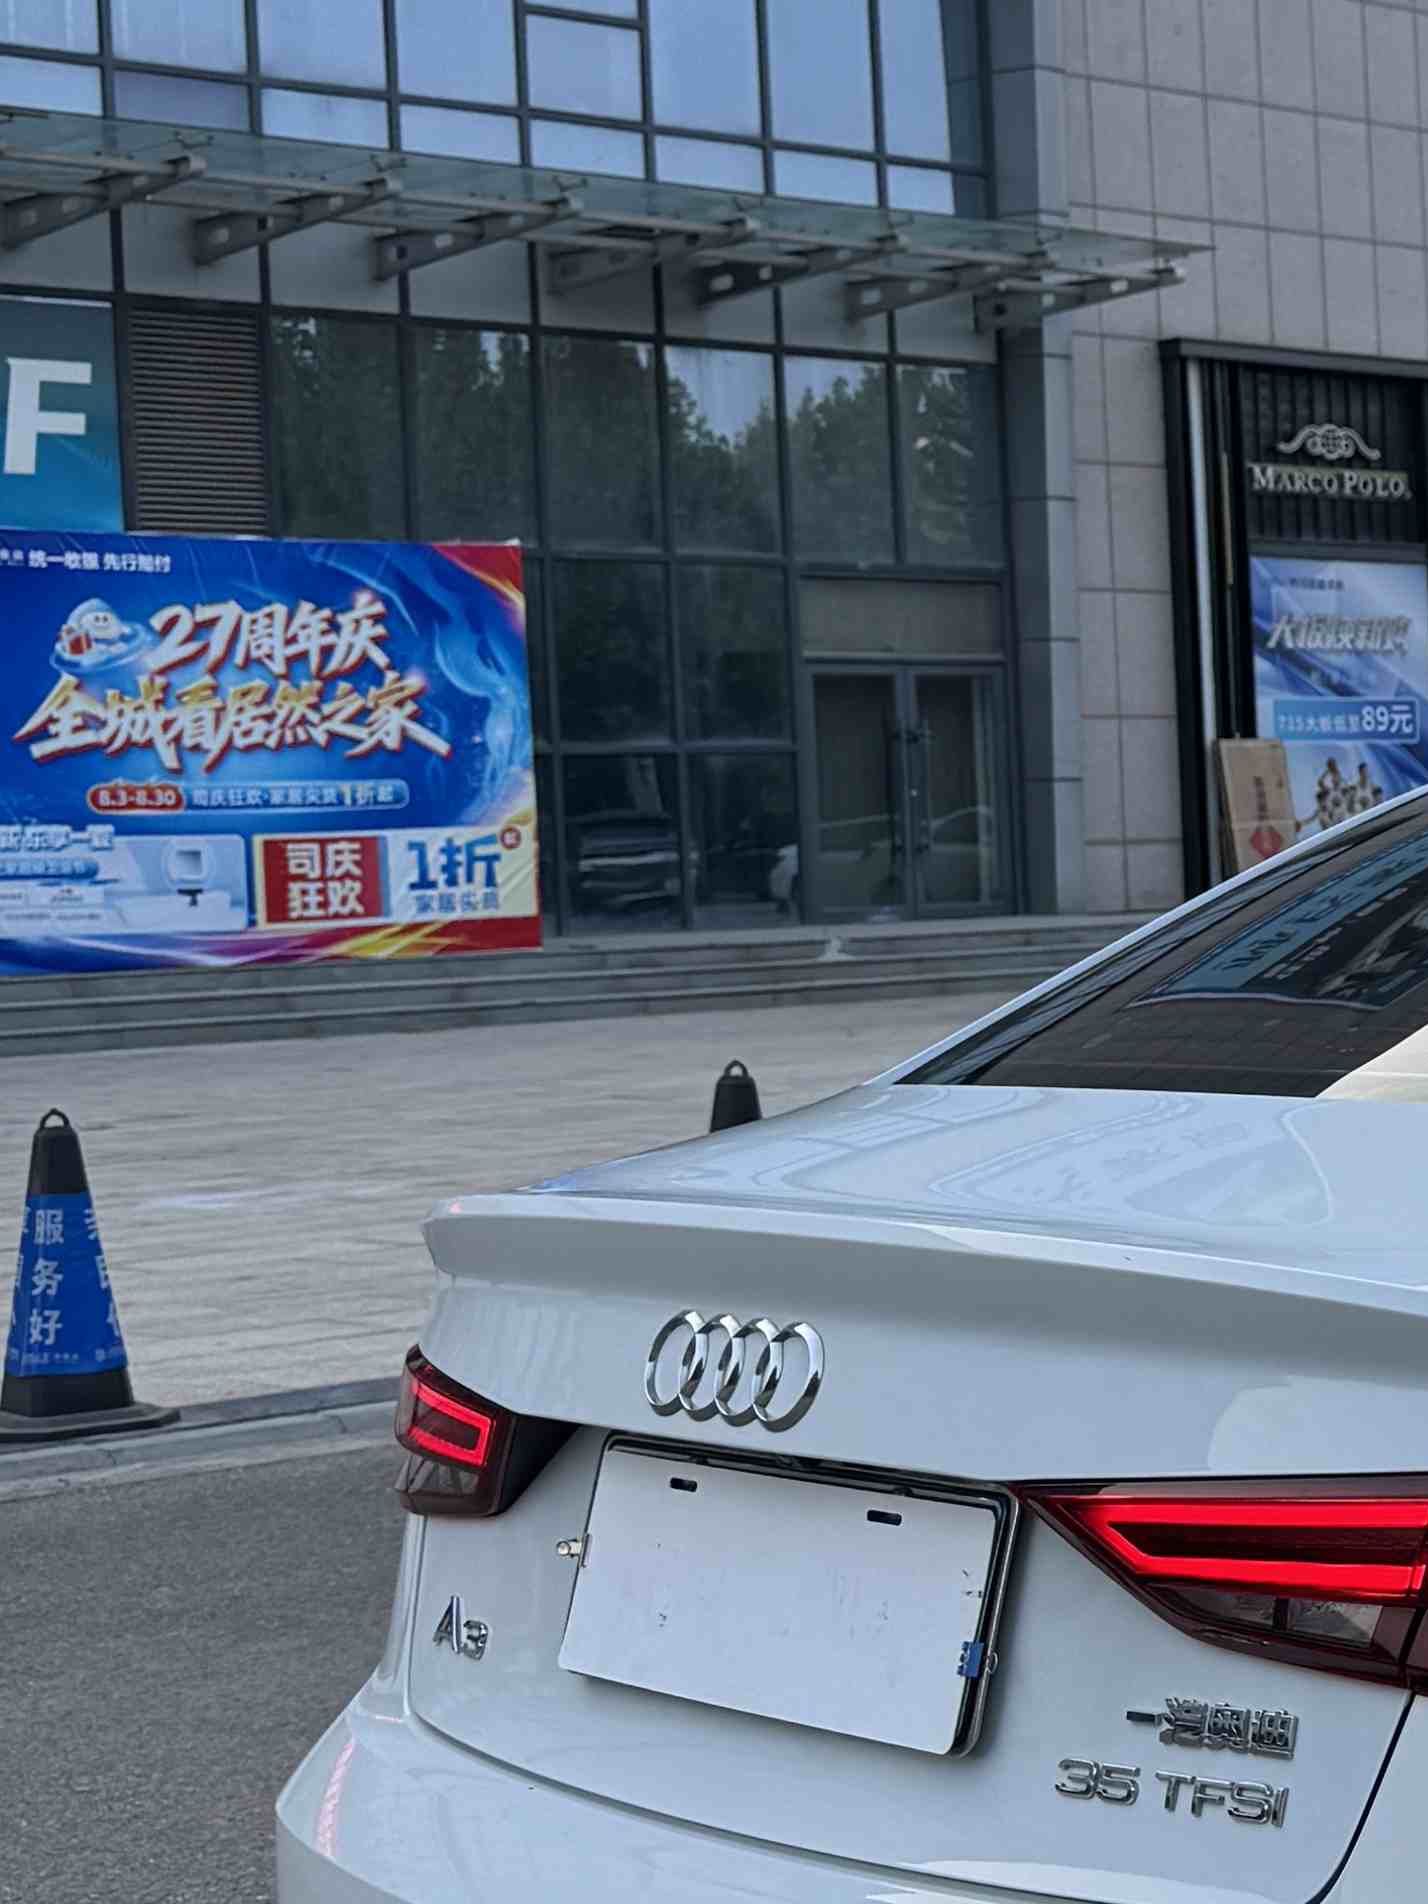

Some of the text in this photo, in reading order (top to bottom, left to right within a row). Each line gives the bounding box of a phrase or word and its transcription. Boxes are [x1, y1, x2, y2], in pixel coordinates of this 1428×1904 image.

[148, 594, 390, 675] 27周年庆
[13, 673, 452, 776] 全城看居然之家
[286, 841, 363, 874] 司庆
[287, 881, 364, 918] 狂欢
[29, 1209, 64, 1345] 服务好
[433, 1596, 488, 1660] A3
[1055, 1758, 1290, 1828] 35 TFSI
